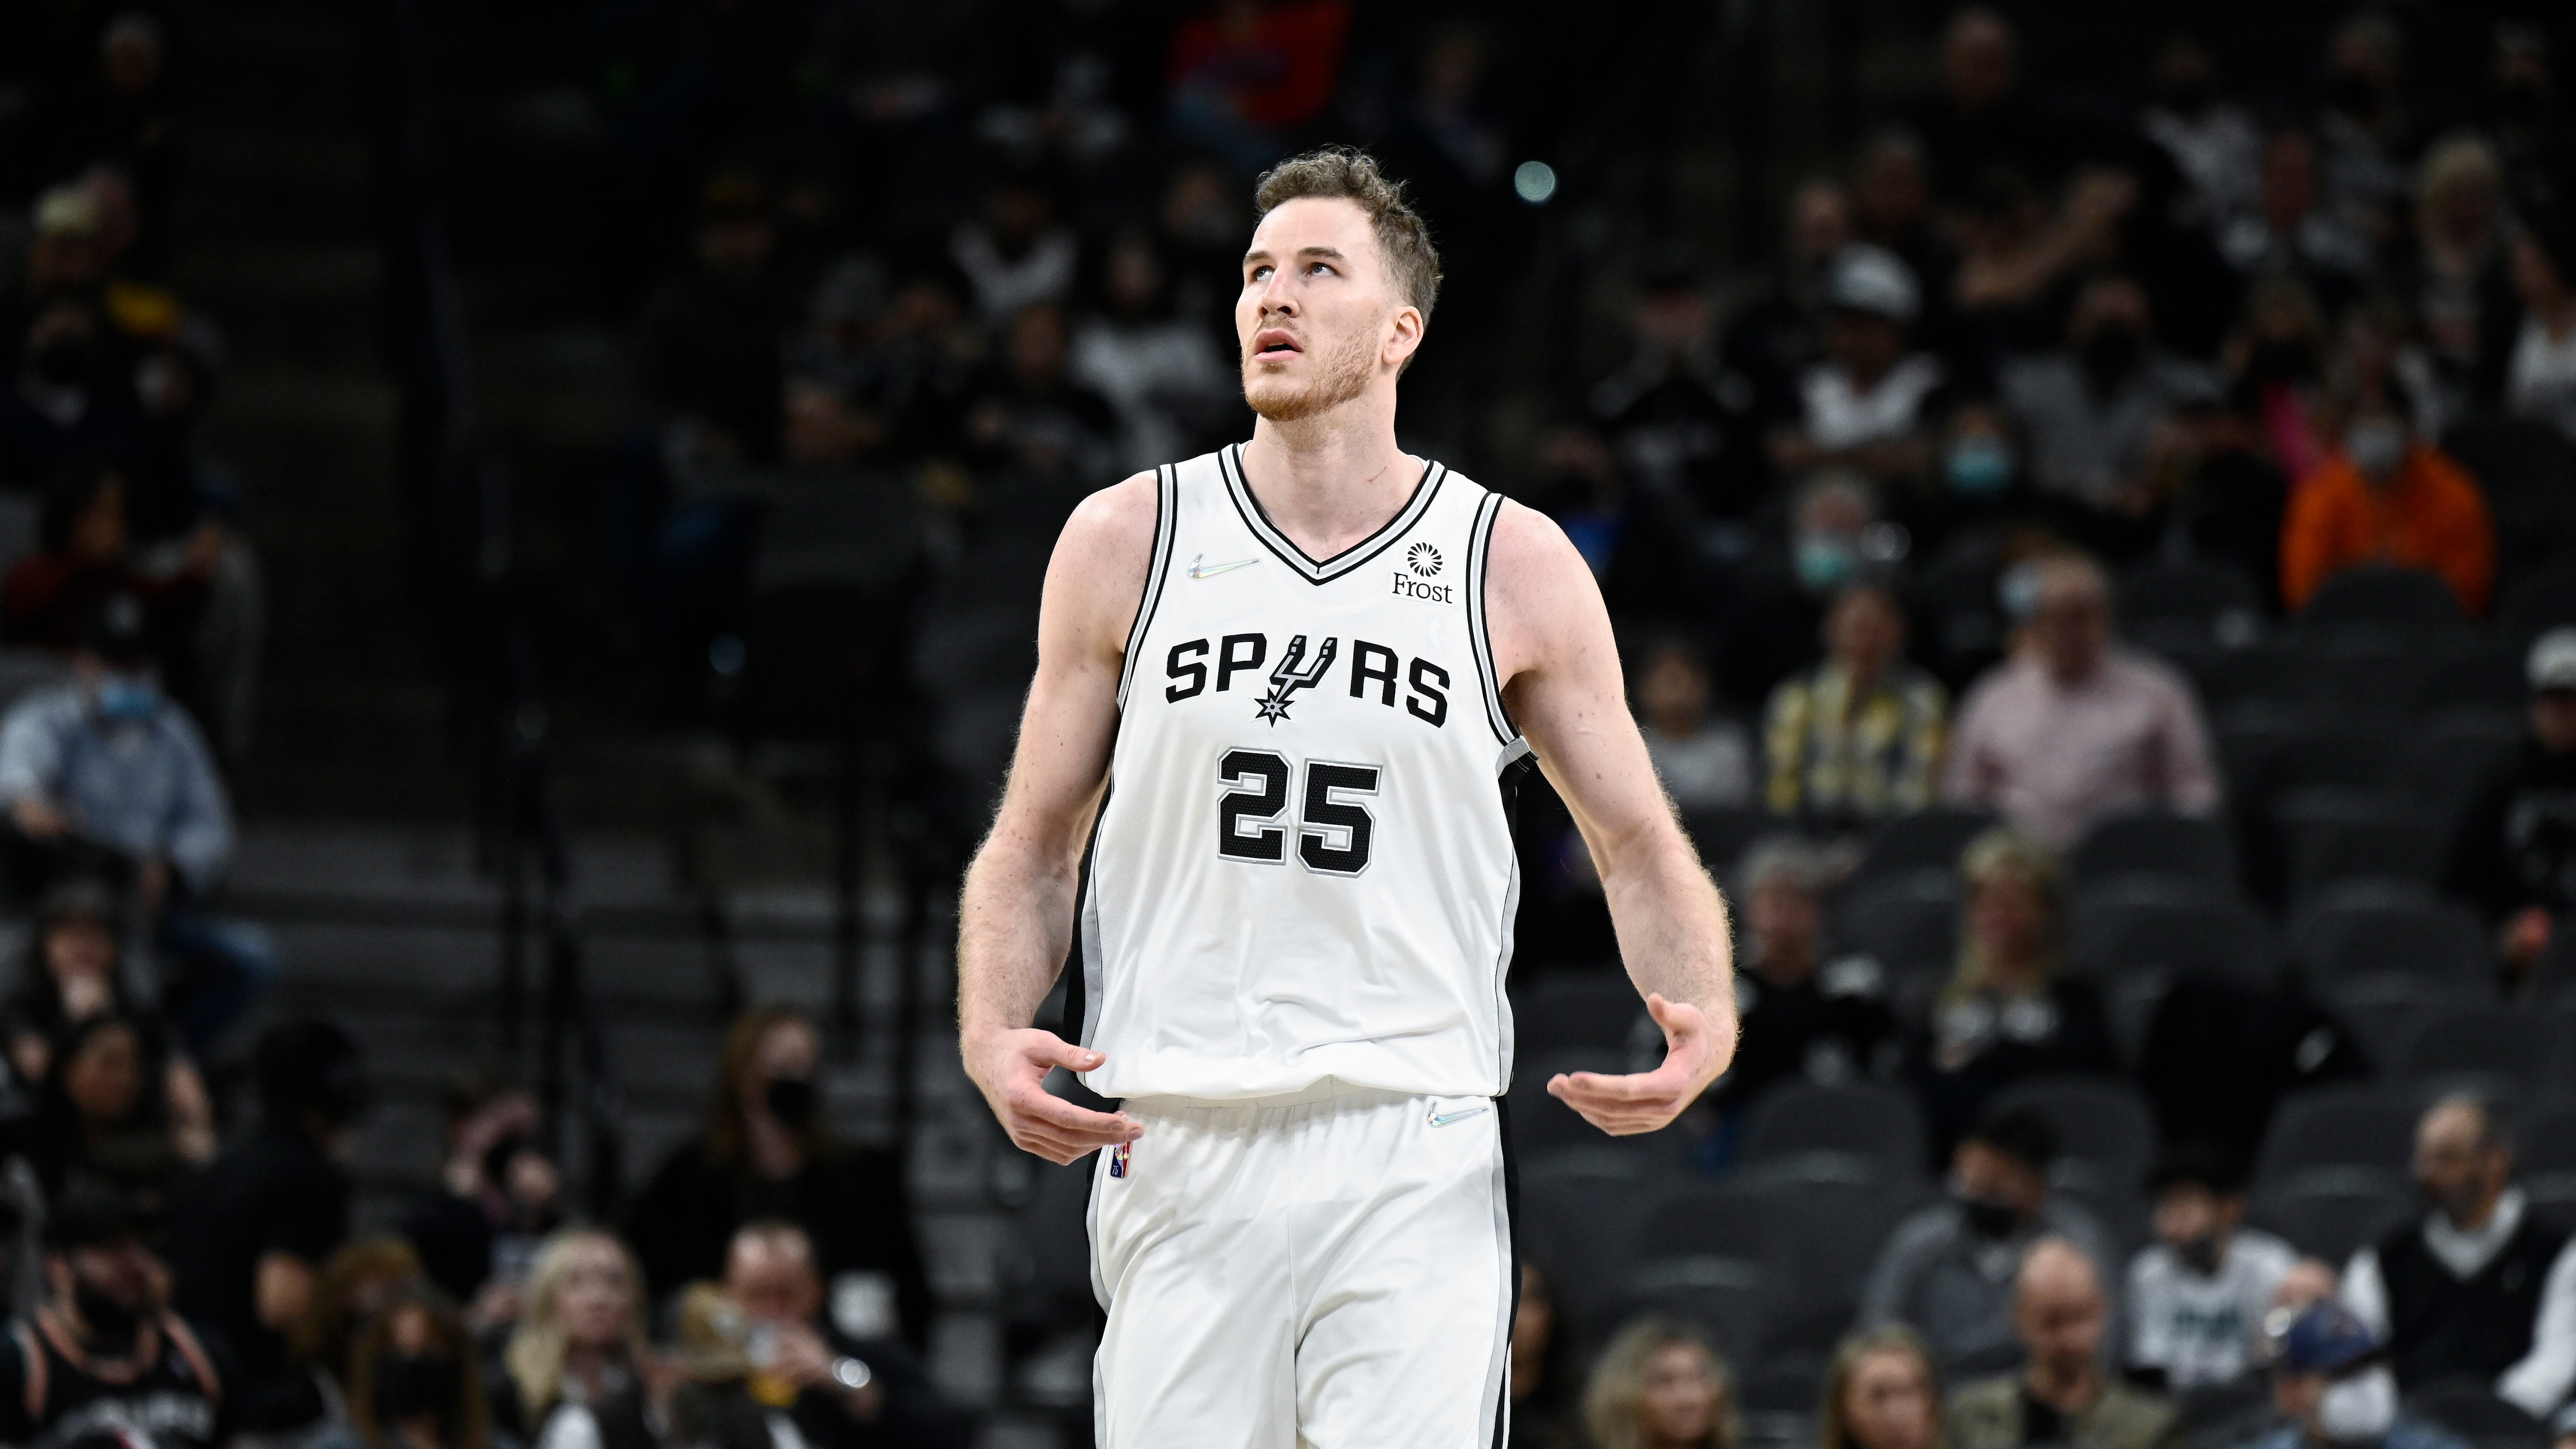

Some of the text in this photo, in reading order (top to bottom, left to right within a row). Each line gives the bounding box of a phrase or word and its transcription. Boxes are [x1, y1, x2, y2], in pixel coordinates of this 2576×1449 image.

[1392, 572, 1453, 604] Frost
[1165, 633, 1451, 728] SPURS
[1217, 746, 1383, 878] 25
[1112, 1165, 1120, 1175] 75
